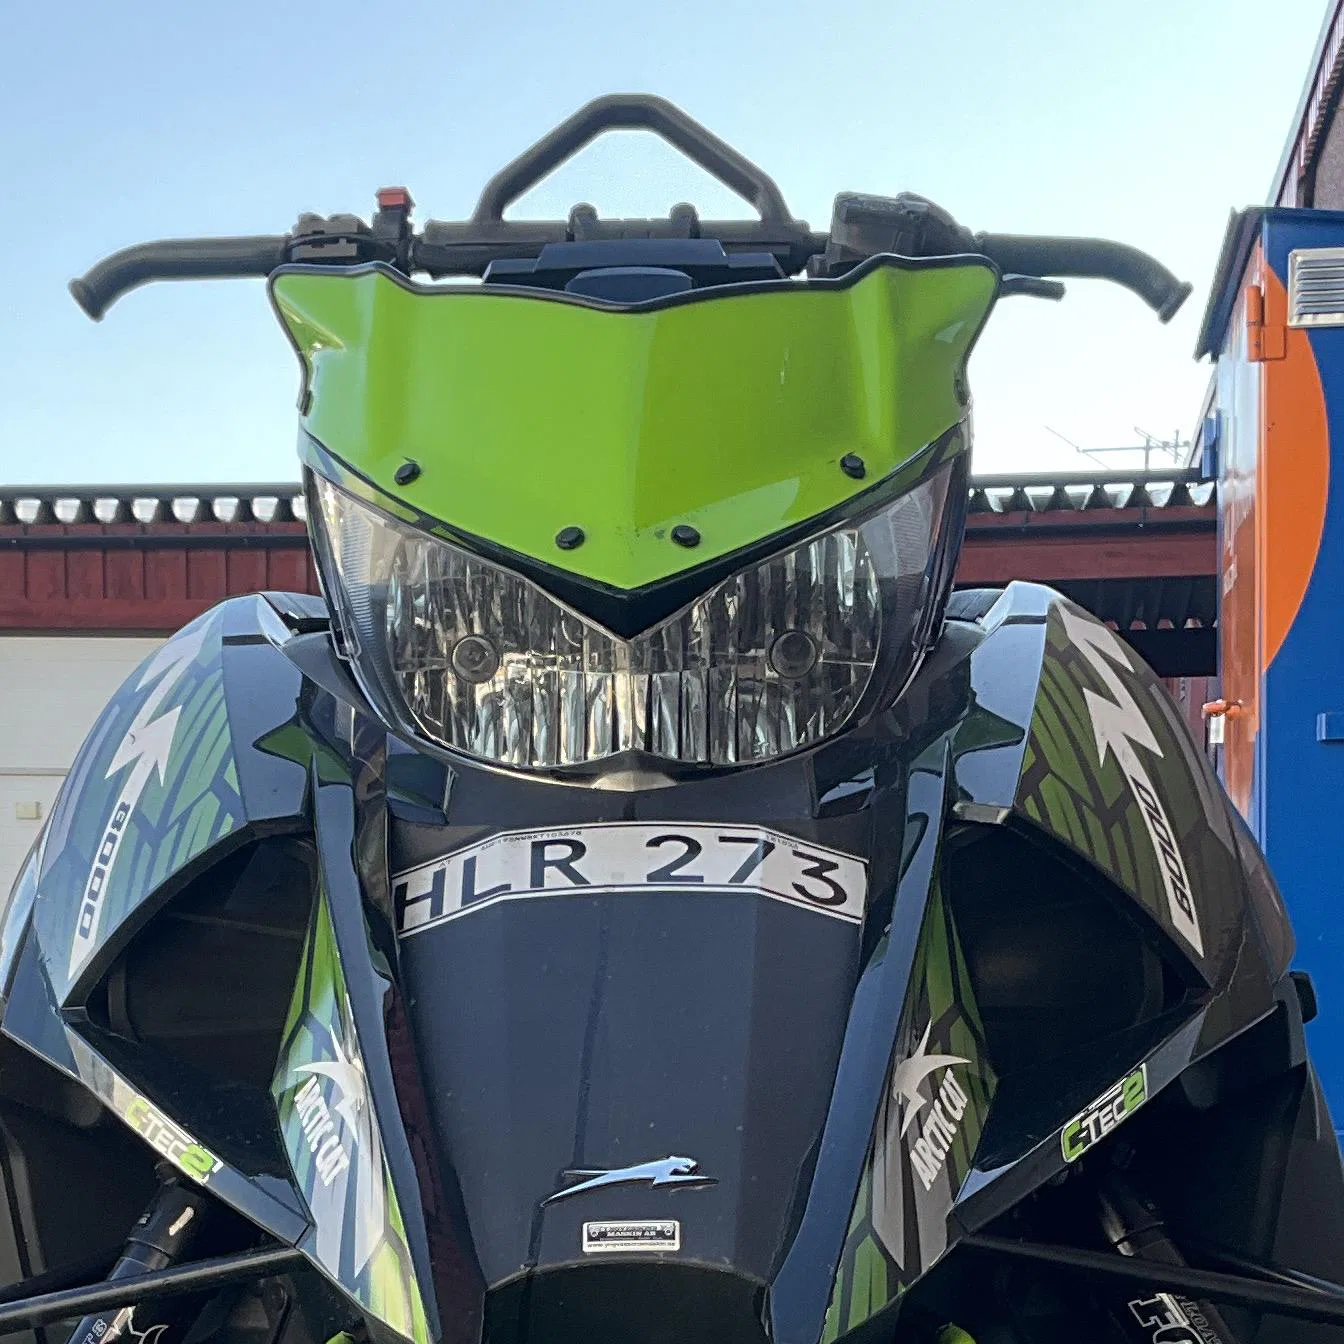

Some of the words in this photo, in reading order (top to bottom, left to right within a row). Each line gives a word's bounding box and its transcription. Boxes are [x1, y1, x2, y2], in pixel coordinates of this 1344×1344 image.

[78, 800, 132, 940] 8000
[392, 838, 592, 930] HLR
[645, 834, 848, 906] 273
[1129, 773, 1195, 925] 8000
[909, 1098, 957, 1192] ARCTIC
[938, 1067, 969, 1122] CAT
